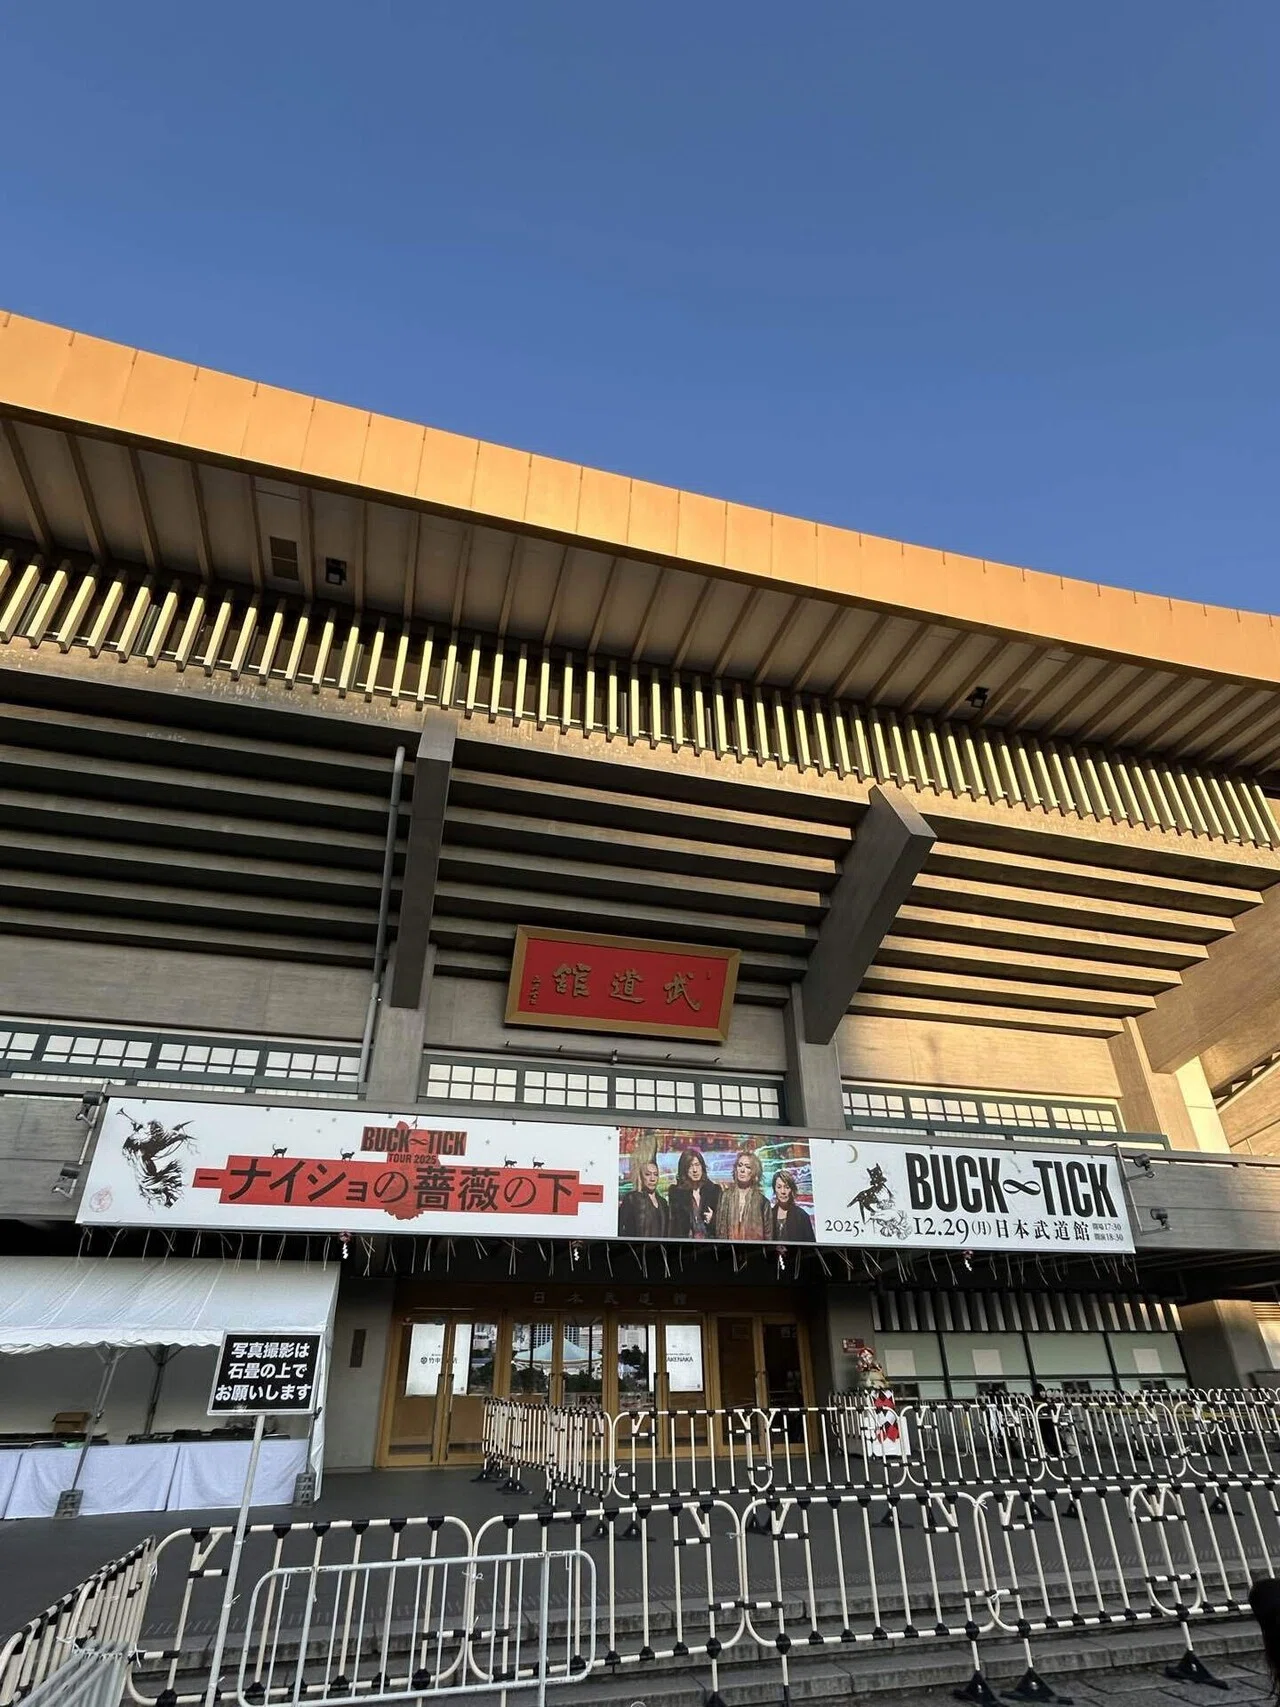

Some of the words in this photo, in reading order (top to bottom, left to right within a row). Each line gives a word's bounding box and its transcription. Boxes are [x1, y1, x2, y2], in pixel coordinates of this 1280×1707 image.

[389, 1154, 412, 1163] TOUR
[414, 1155, 436, 1164] 2025
[825, 1219, 865, 1238] 2025.
[231, 1342, 310, 1358] 写真撮影は
[228, 1362, 307, 1379] 石畳の上で
[215, 1384, 311, 1401] お願いします
